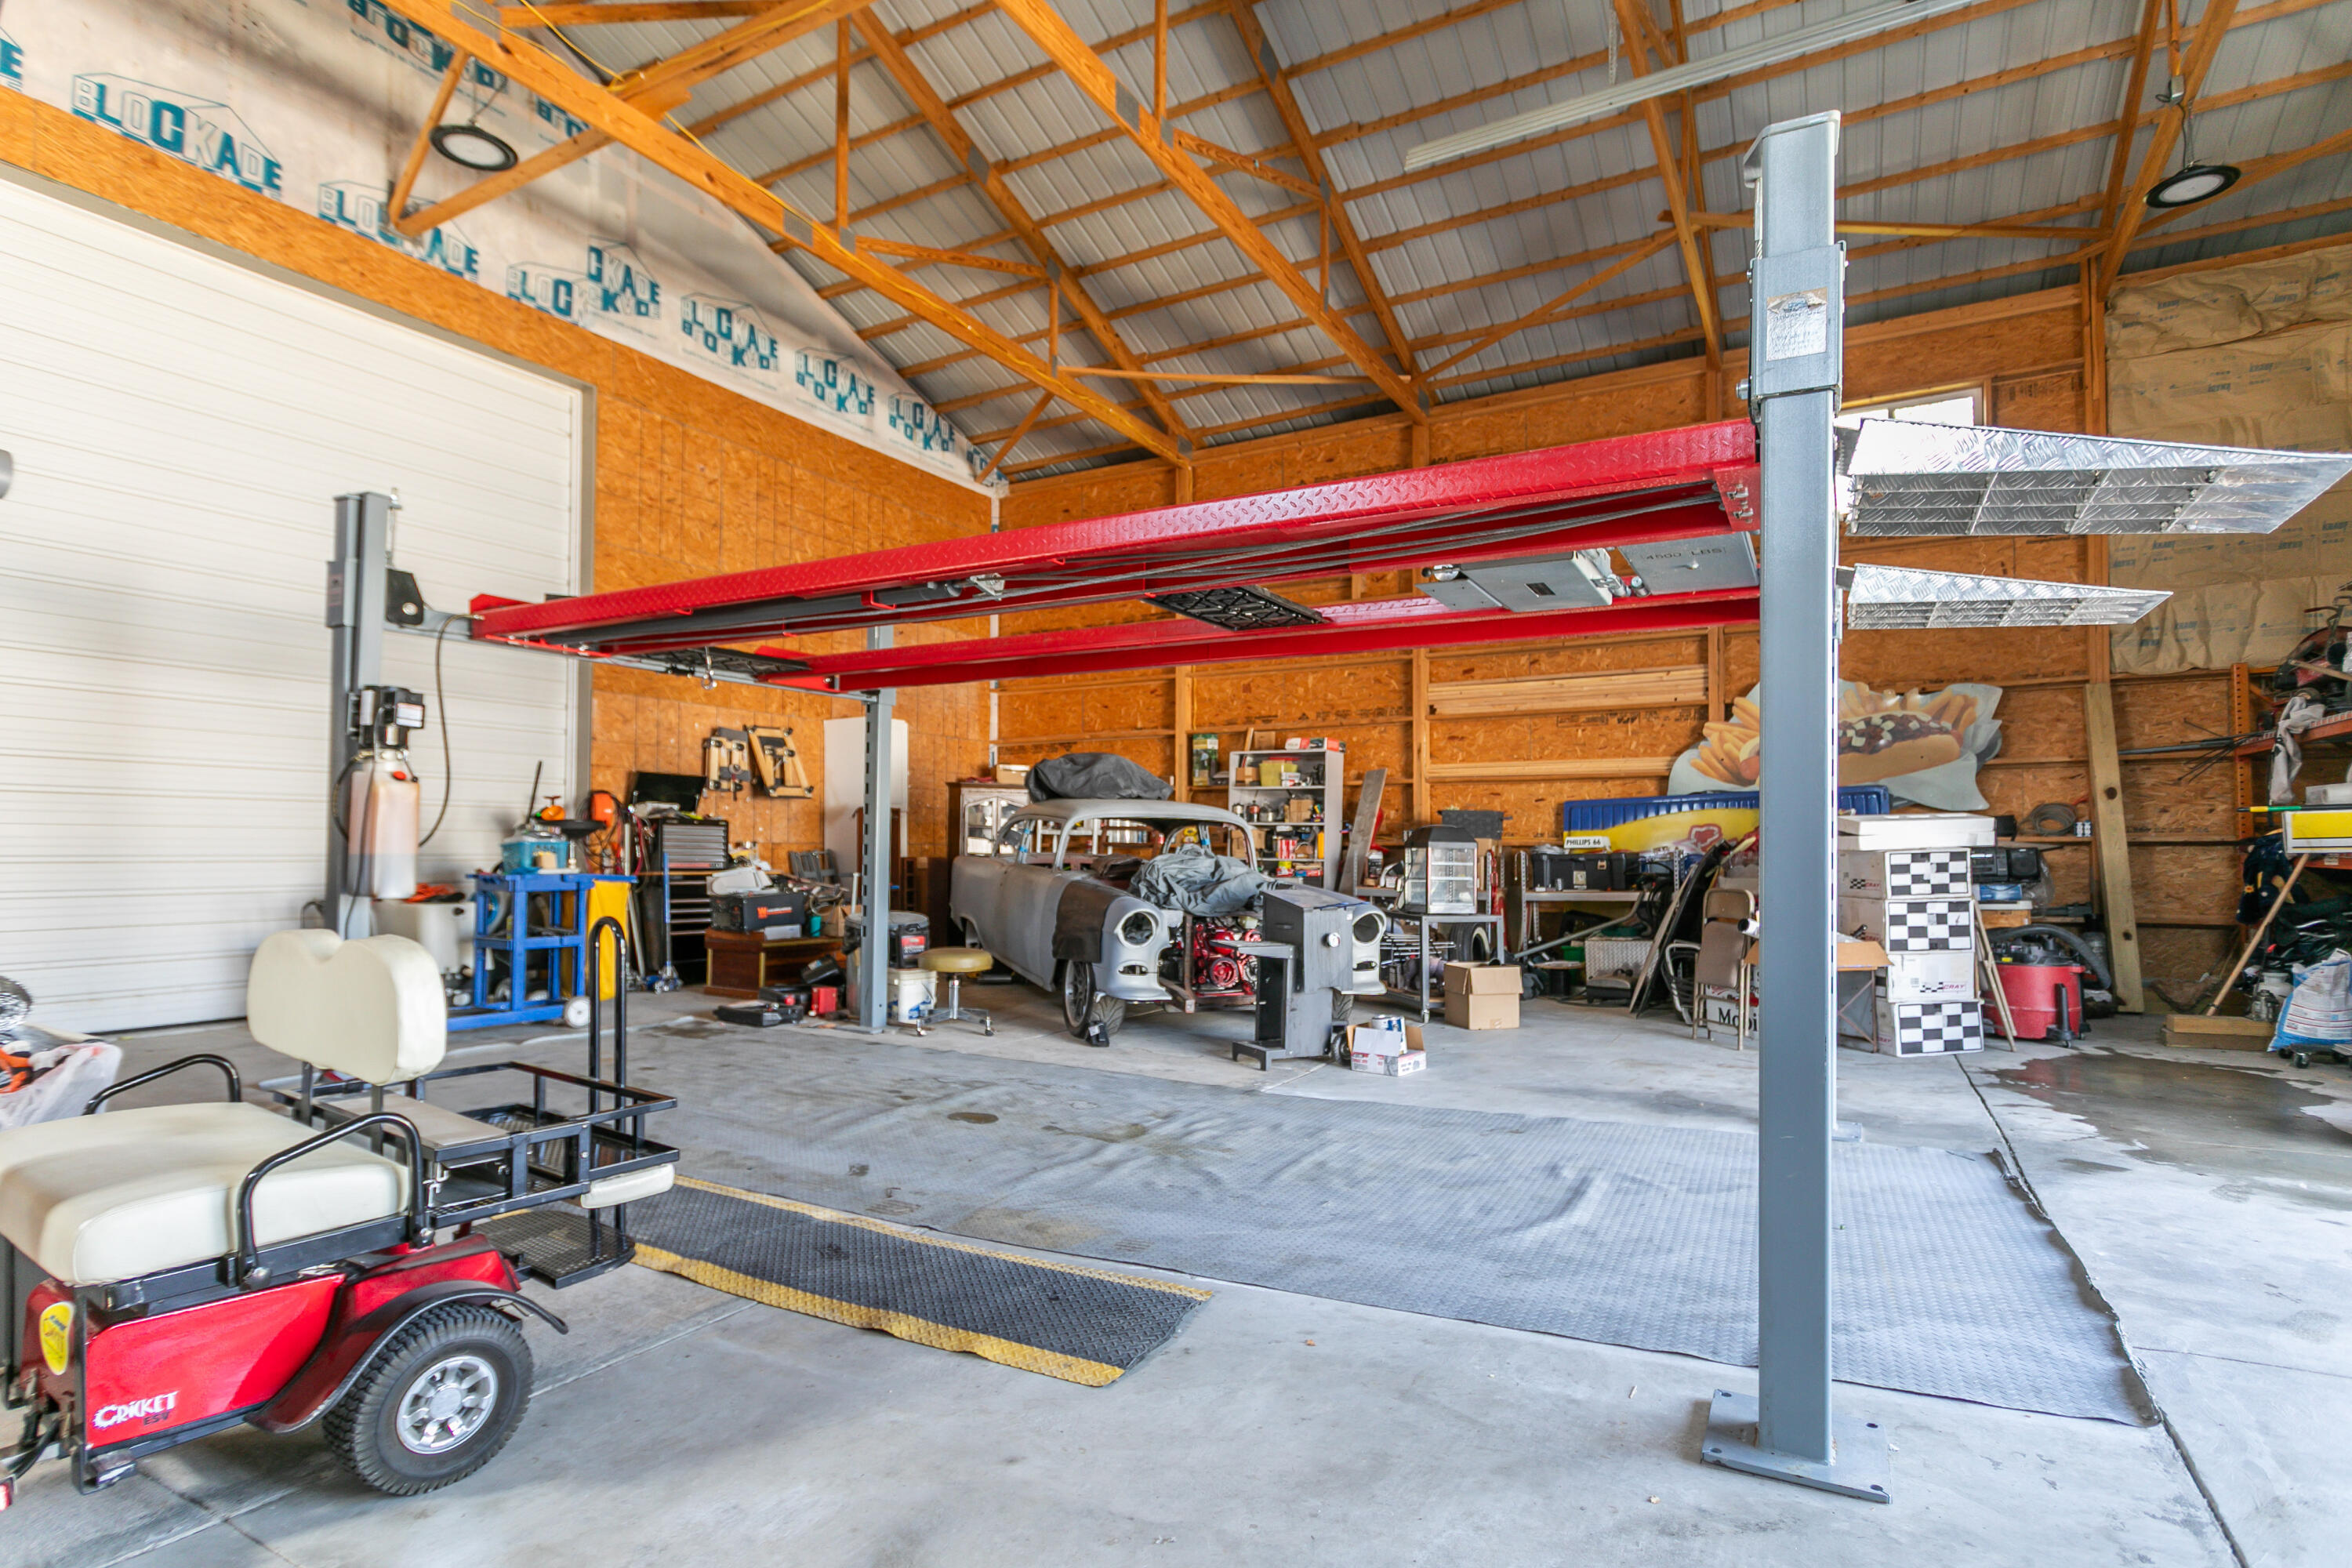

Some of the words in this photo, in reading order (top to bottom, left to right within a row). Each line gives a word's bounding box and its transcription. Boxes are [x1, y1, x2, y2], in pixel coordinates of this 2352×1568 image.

[72, 74, 283, 191] BLOCKADE
[318, 183, 479, 274] BLOADE
[681, 296, 779, 358] BLOCKADE
[795, 350, 876, 405] BLOCKADE
[92, 1391, 179, 1429] CRICKET
[143, 1412, 170, 1426] ESV
